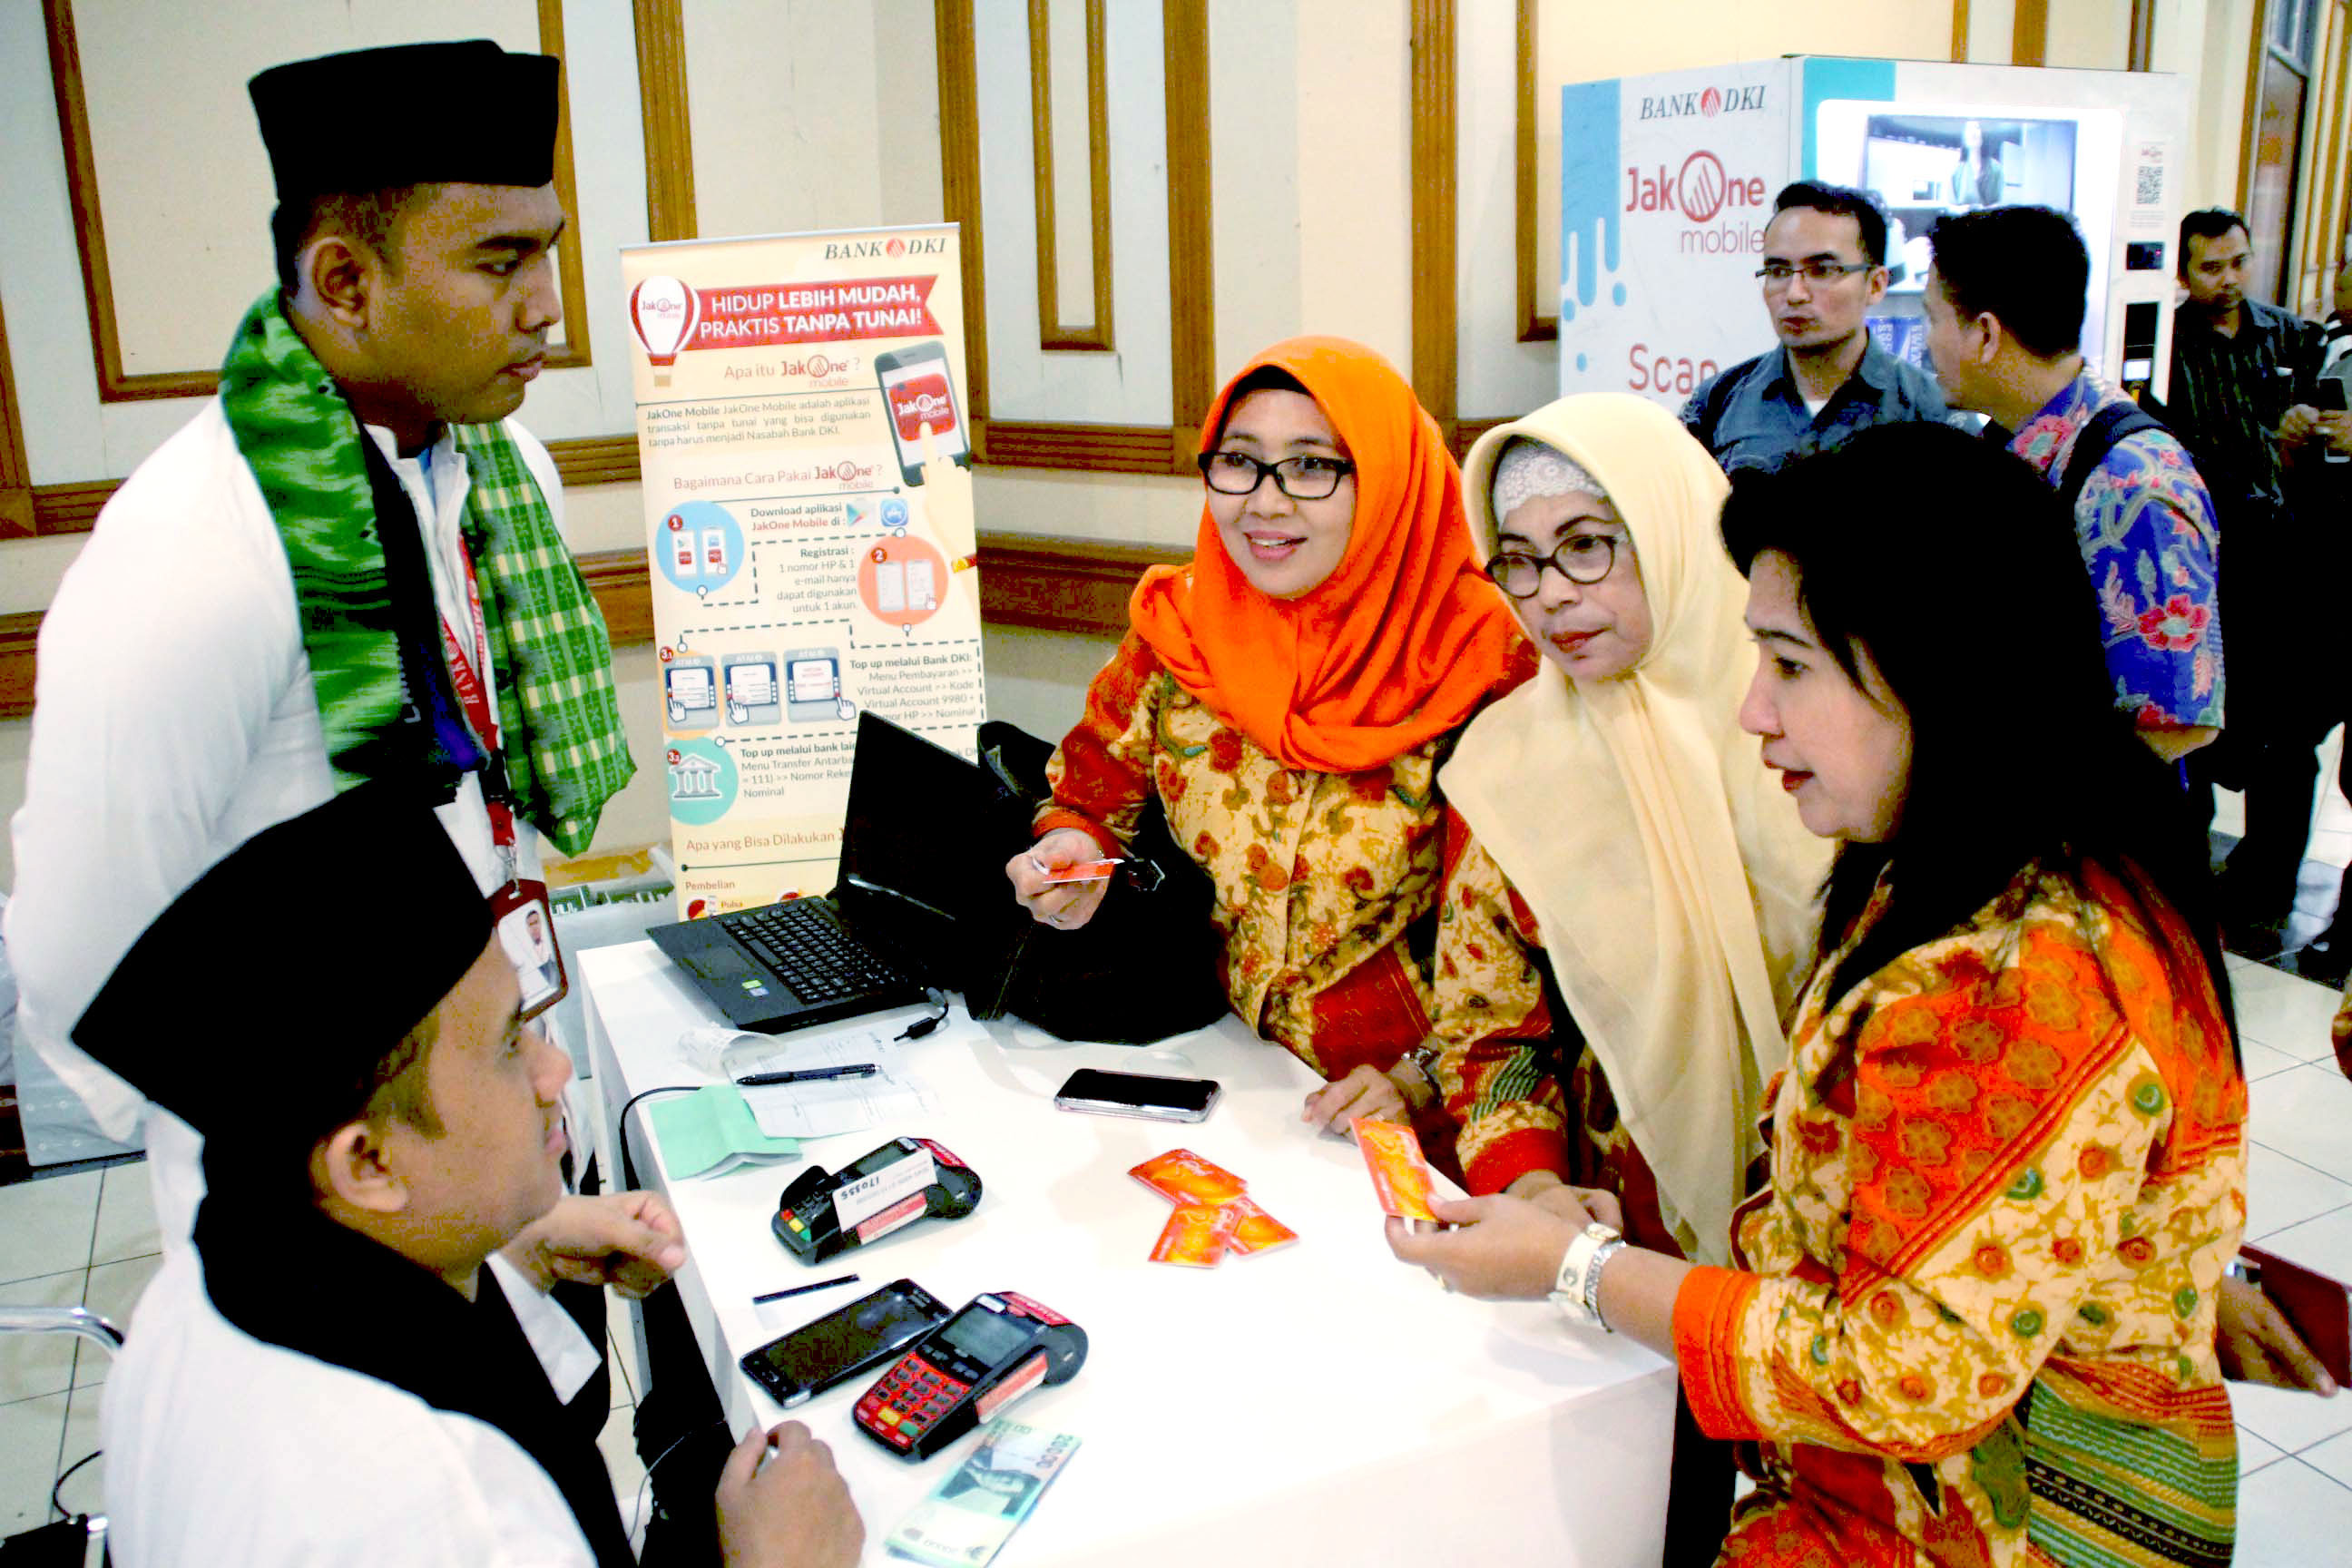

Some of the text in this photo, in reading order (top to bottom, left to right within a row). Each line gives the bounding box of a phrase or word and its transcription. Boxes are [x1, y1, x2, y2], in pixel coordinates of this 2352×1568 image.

[1639, 84, 1767, 120] BANK DKI
[1625, 149, 1767, 223] JakOne
[1681, 220, 1765, 254] mobile
[825, 237, 947, 260] BANK DKI
[710, 282, 922, 314] HIDUP LEBIH MUDAH,
[700, 307, 922, 338] PRAKTIS TANPA TUNAI!
[724, 364, 752, 381] Apa
[756, 365, 775, 377] itu
[779, 355, 848, 378] JakOne
[808, 377, 849, 388] mobile
[646, 397, 870, 420] JakOne Mobile JakOne Mobile adalah aplikasi
[897, 393, 946, 416] JakOne
[647, 411, 871, 434] transaksi tanpa tunai yang bisa digunakan
[648, 436, 675, 449] tanpa
[675, 435, 704, 446] harus
[705, 432, 745, 445] menjadi
[746, 429, 790, 441] Nasabah
[791, 427, 816, 438] Bank
[673, 474, 742, 491] Bagaimana
[744, 472, 775, 485] Cara
[778, 469, 811, 482] Pakai
[814, 461, 873, 482] JakOne
[838, 479, 873, 491] mobile
[750, 502, 842, 518] Download aplikasi
[751, 520, 790, 532] JakOne
[792, 518, 828, 529] Mobile
[830, 516, 840, 526] di
[799, 545, 849, 559] Registrasi
[875, 549, 884, 560] 2
[779, 564, 784, 573] 1
[787, 563, 818, 573] nomor
[821, 560, 837, 570] HP
[849, 559, 855, 569] 1
[794, 573, 857, 585] e-mail hanya
[777, 587, 858, 601] dapat digunakan
[792, 602, 821, 613] untuk
[824, 601, 829, 611] 1
[849, 660, 867, 671] Top
[870, 660, 883, 670] up
[885, 656, 921, 667] melalui
[923, 655, 948, 665] Bank
[868, 672, 898, 681] Menu
[899, 669, 959, 681] Pembayaran
[858, 684, 890, 696] Virtual
[892, 683, 933, 694] Account
[949, 681, 975, 691] Kode
[864, 699, 897, 709] Virtual
[899, 697, 940, 708] Account
[904, 710, 919, 720] HP
[936, 707, 976, 718] Nominal
[740, 748, 759, 759] Top
[760, 748, 774, 759] up
[776, 744, 812, 756] melalui
[814, 742, 838, 753] bank
[741, 762, 769, 771] Menu
[772, 759, 811, 769] Transfer
[790, 770, 824, 781] Nomor
[827, 769, 852, 779] Reke
[743, 786, 785, 799] Nominal
[686, 839, 710, 853] Apa
[711, 838, 742, 852] yang
[743, 834, 770, 848] Bisa
[773, 830, 836, 846] Dilakukan
[685, 879, 736, 891] Pembelian
